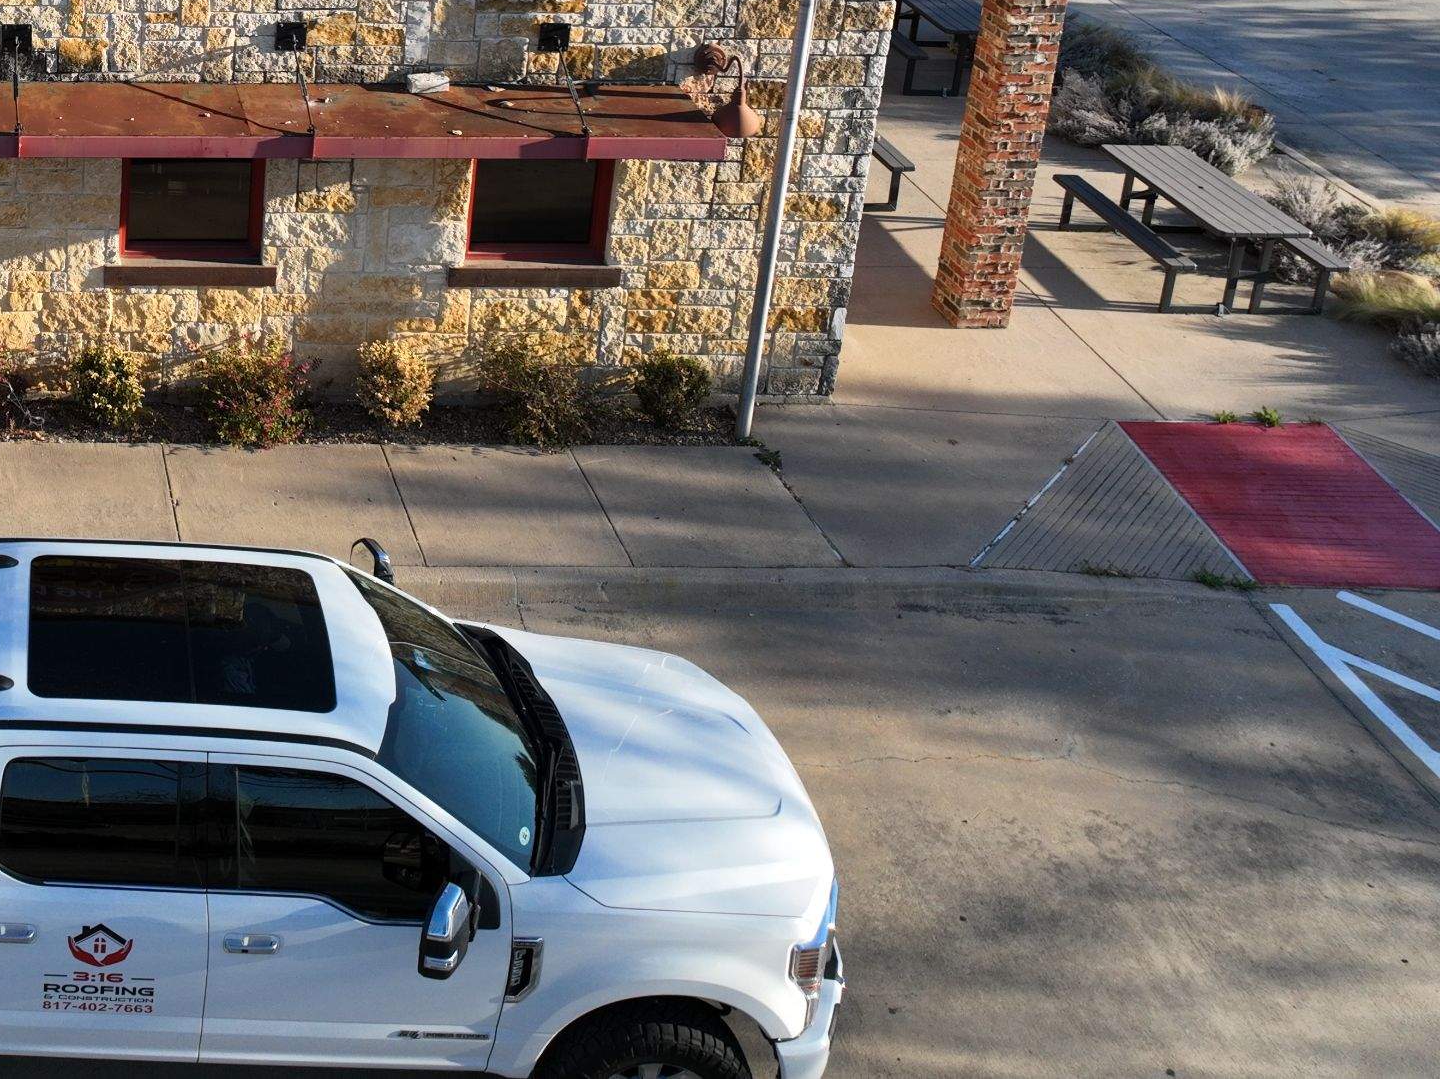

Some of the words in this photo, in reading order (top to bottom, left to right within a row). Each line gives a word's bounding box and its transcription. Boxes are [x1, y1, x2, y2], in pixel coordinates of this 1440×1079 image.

[72, 971, 124, 983] 3:16
[43, 983, 155, 997] ROOFING
[58, 994, 154, 1003] CONSTRUCTION
[42, 1001, 153, 1014] 817-402-7663
